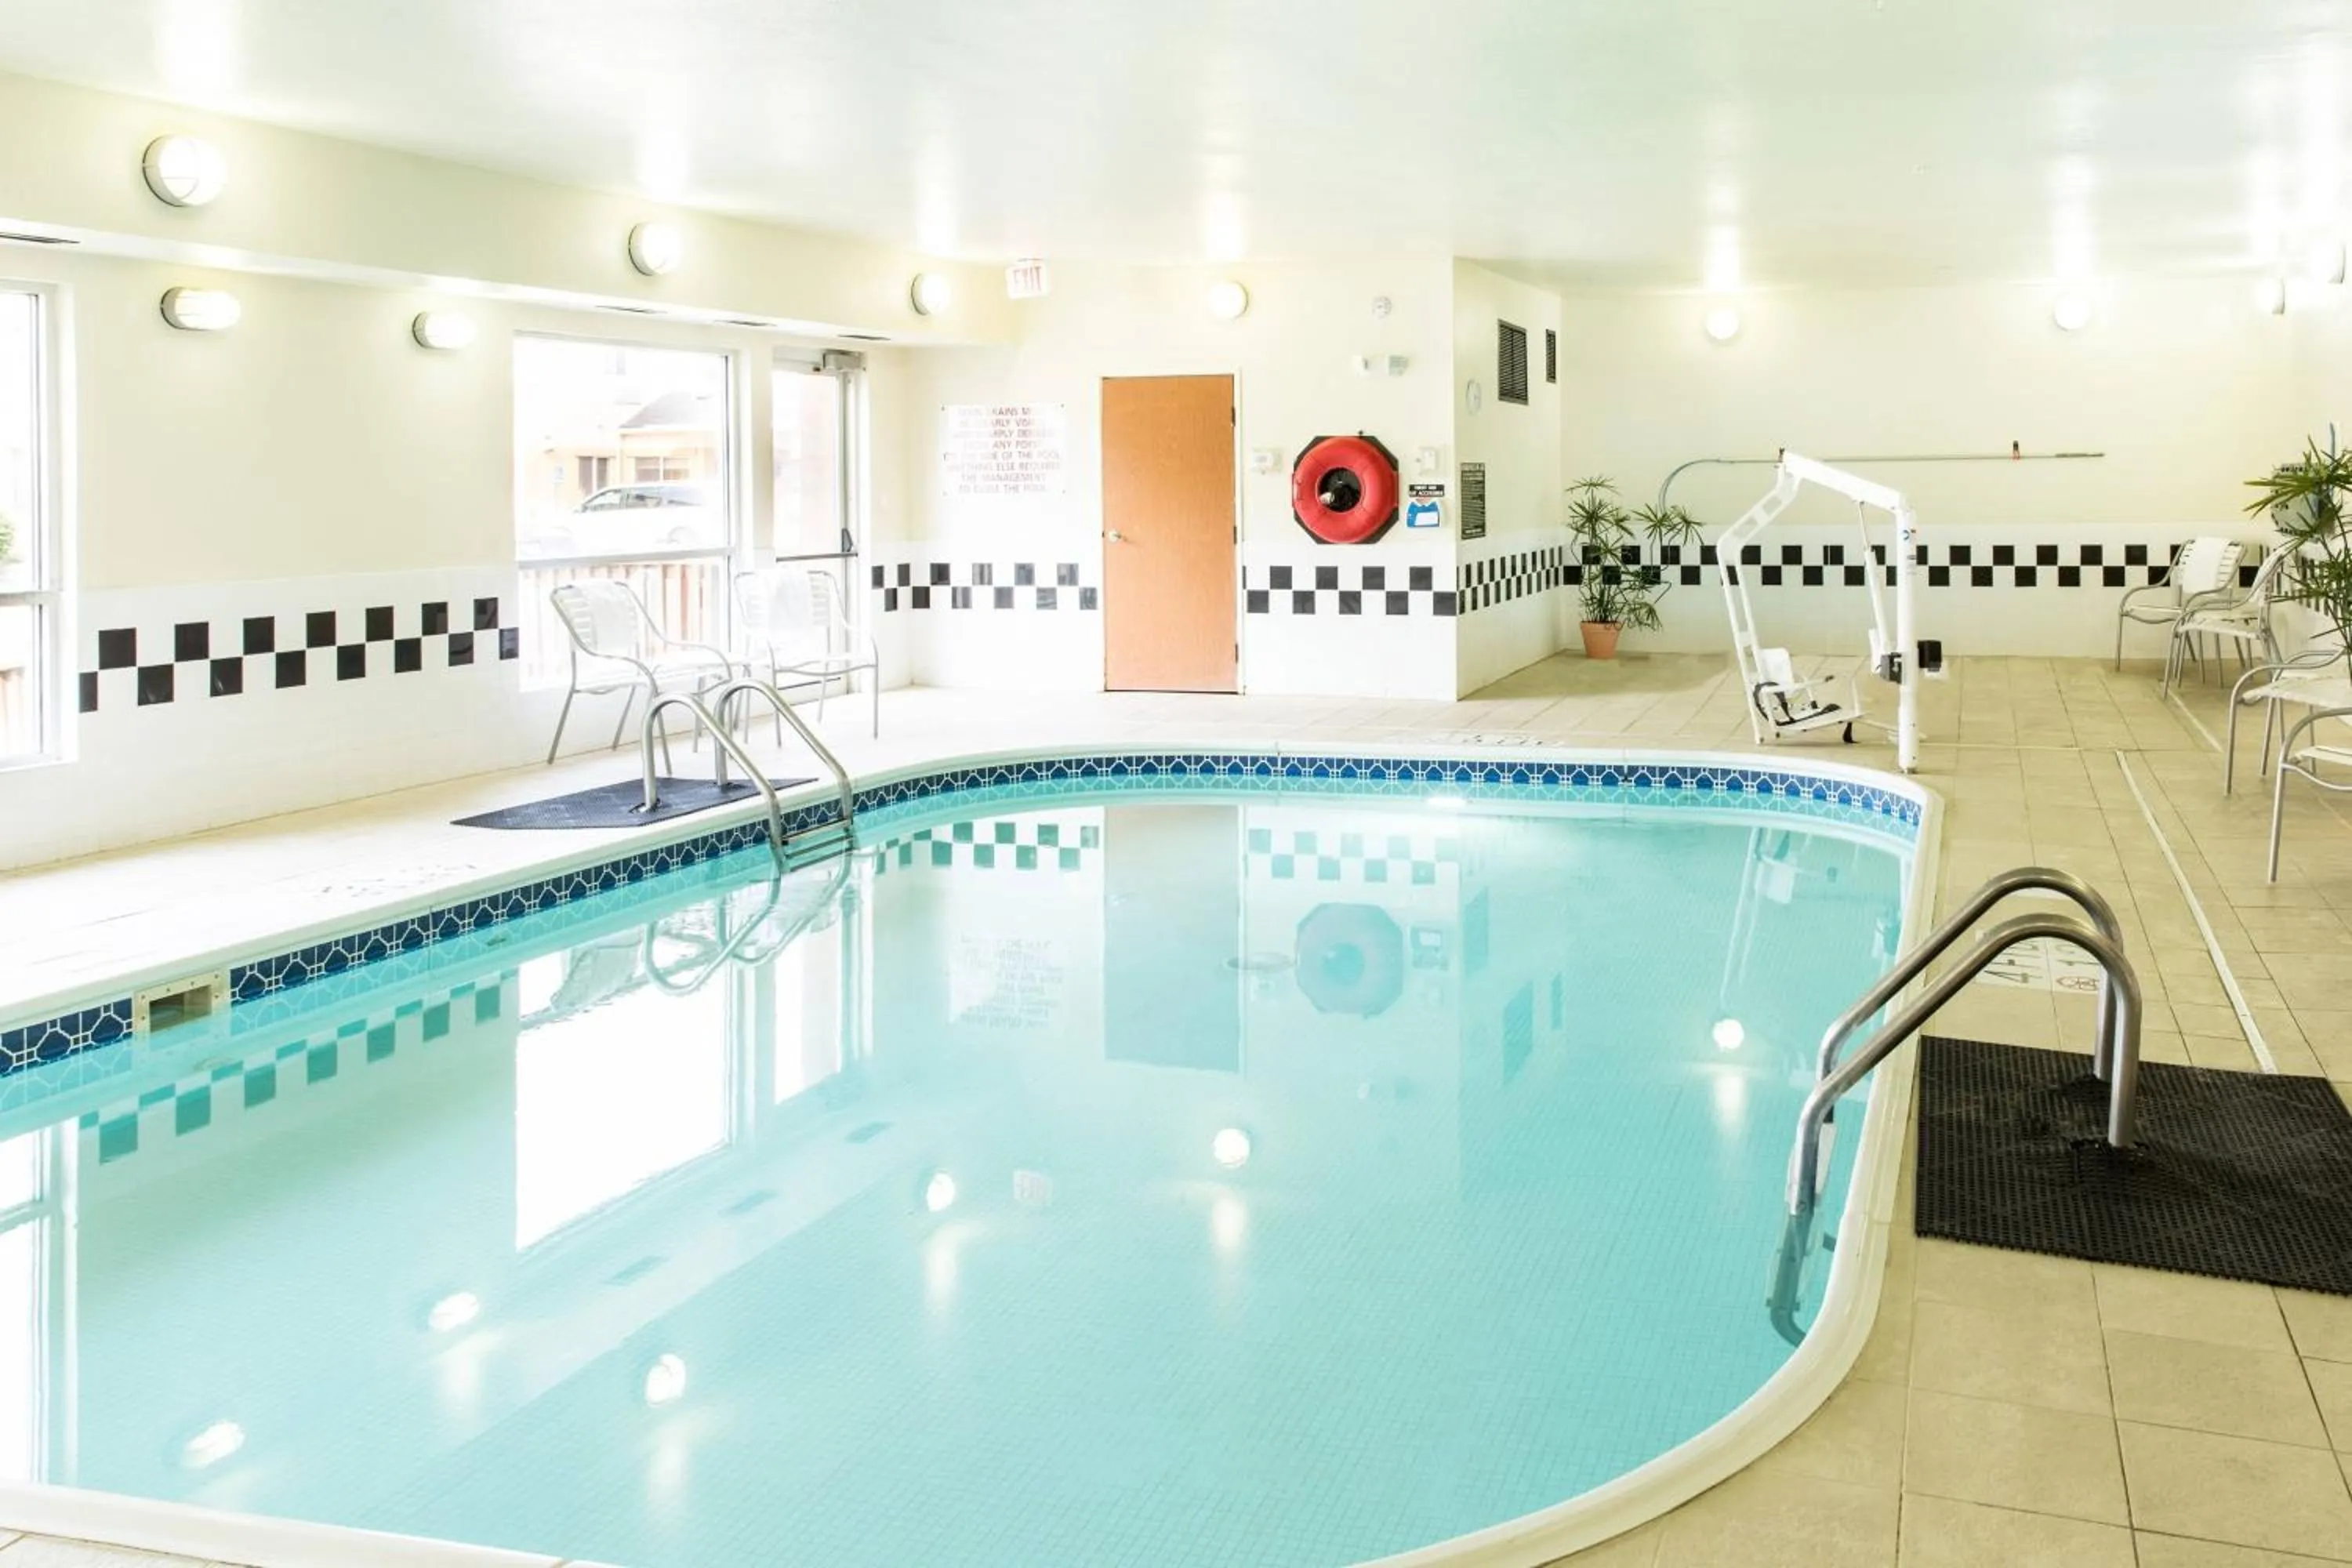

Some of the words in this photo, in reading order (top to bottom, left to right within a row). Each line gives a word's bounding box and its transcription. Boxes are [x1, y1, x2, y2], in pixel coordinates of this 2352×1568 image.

[992, 440, 1011, 449] ANY
[1018, 450, 1033, 459] THE
[996, 462, 1015, 471] ELSE
[1003, 484, 1020, 494] THE
